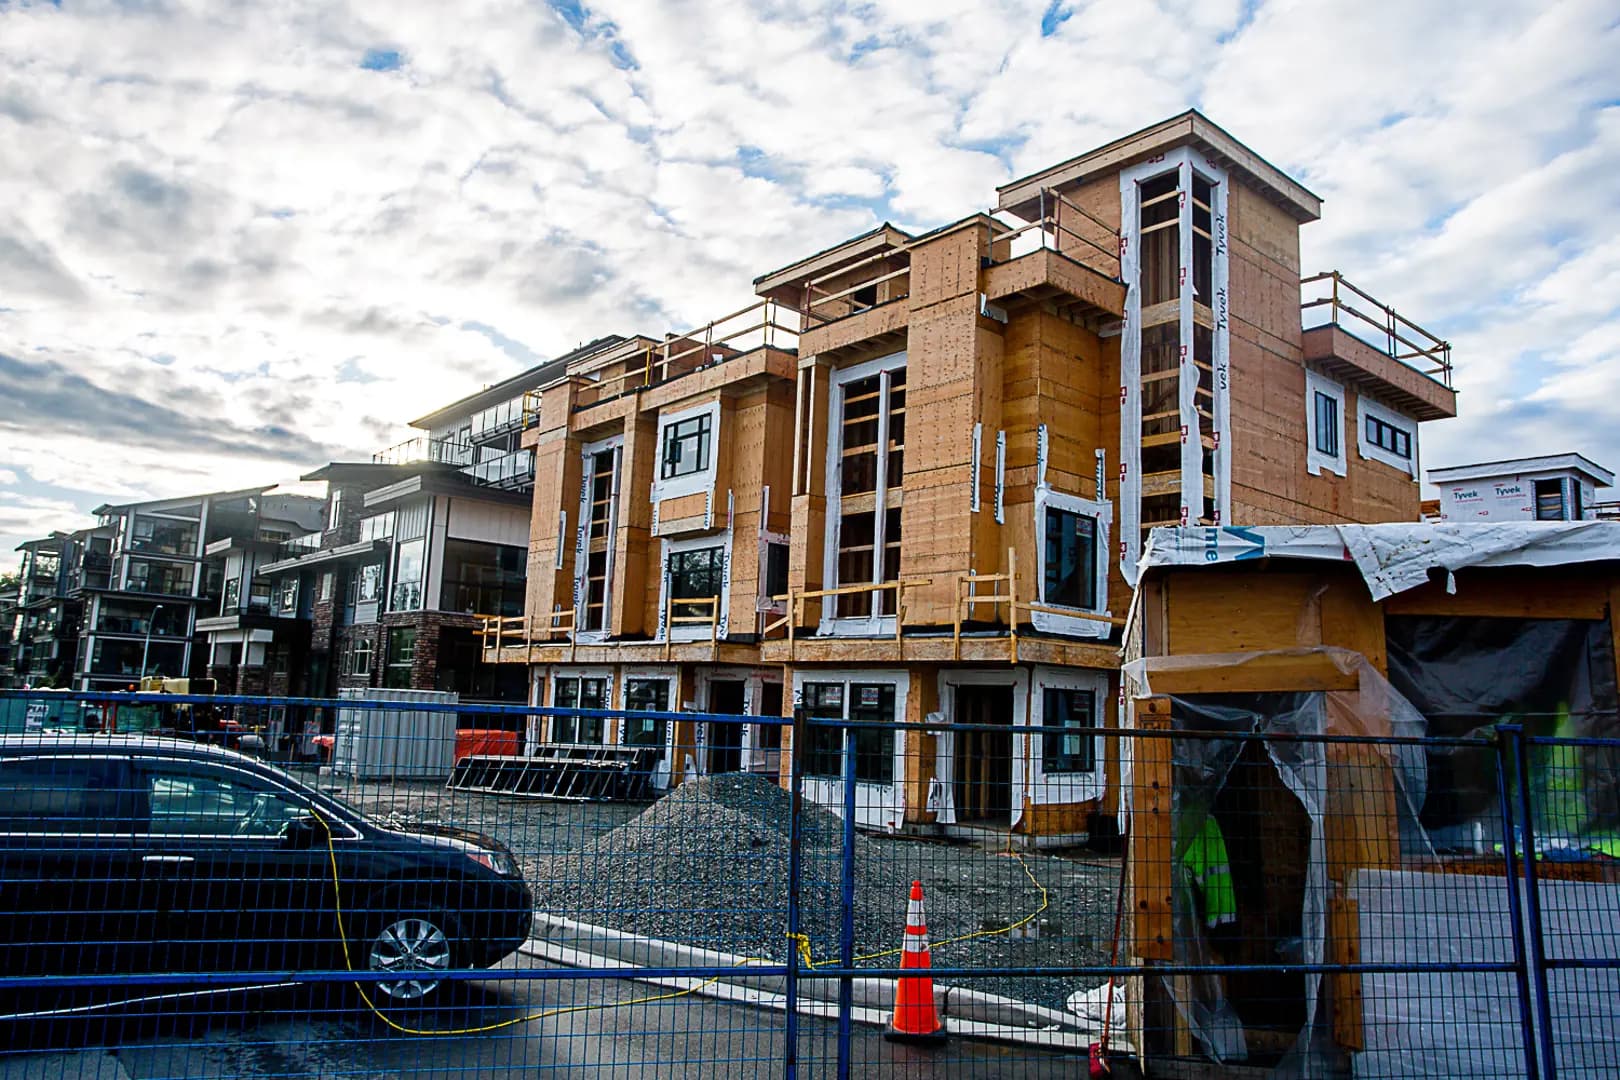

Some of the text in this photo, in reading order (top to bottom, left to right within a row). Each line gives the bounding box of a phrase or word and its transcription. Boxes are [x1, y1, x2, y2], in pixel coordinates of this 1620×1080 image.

[1215, 213, 1227, 256] Tyvek
[1216, 287, 1228, 331] Tyvek
[1454, 490, 1479, 500] Tyvek
[1495, 485, 1521, 496] Tyvek
